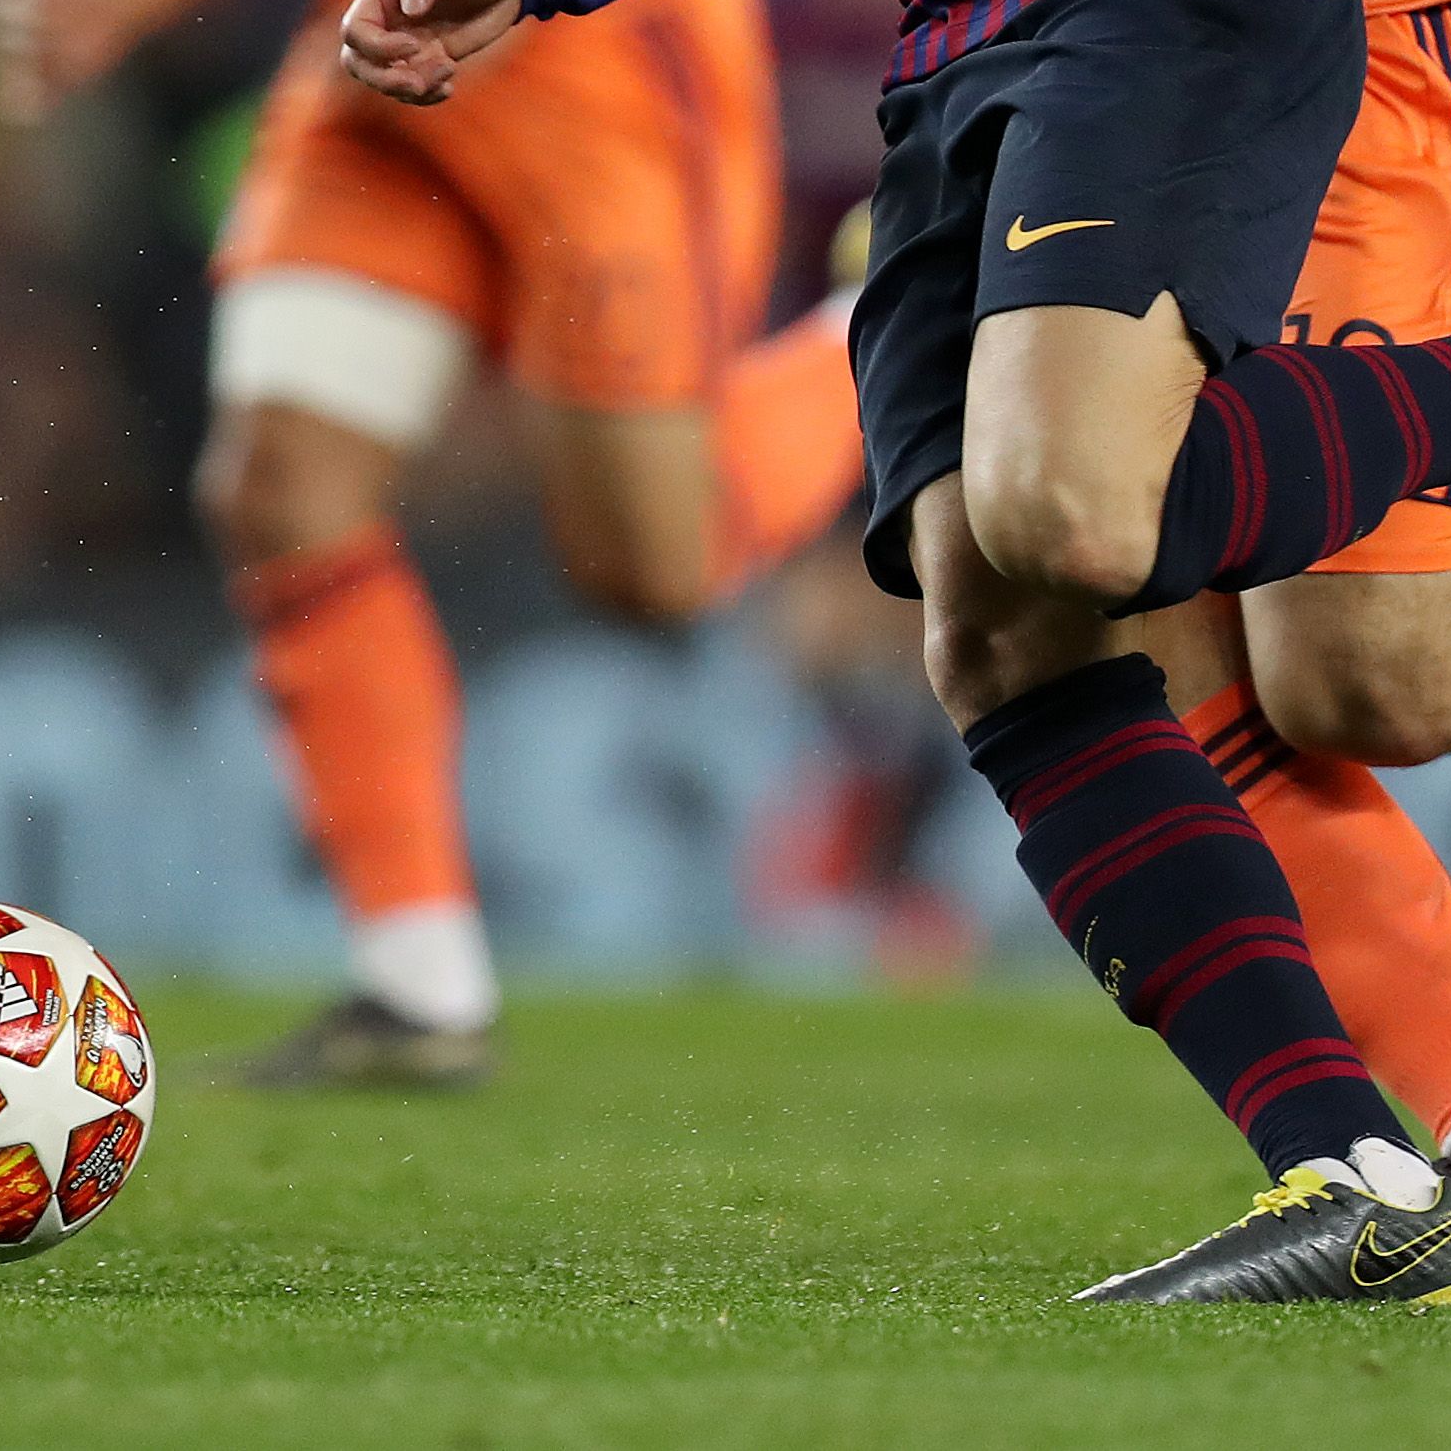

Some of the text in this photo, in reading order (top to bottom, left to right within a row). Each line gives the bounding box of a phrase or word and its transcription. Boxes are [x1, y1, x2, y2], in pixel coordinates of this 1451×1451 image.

[82, 1002, 94, 1041] FINAL
[70, 1125, 124, 1190] CHAMPIONS
[76, 1137, 111, 1170] LEAGUE
